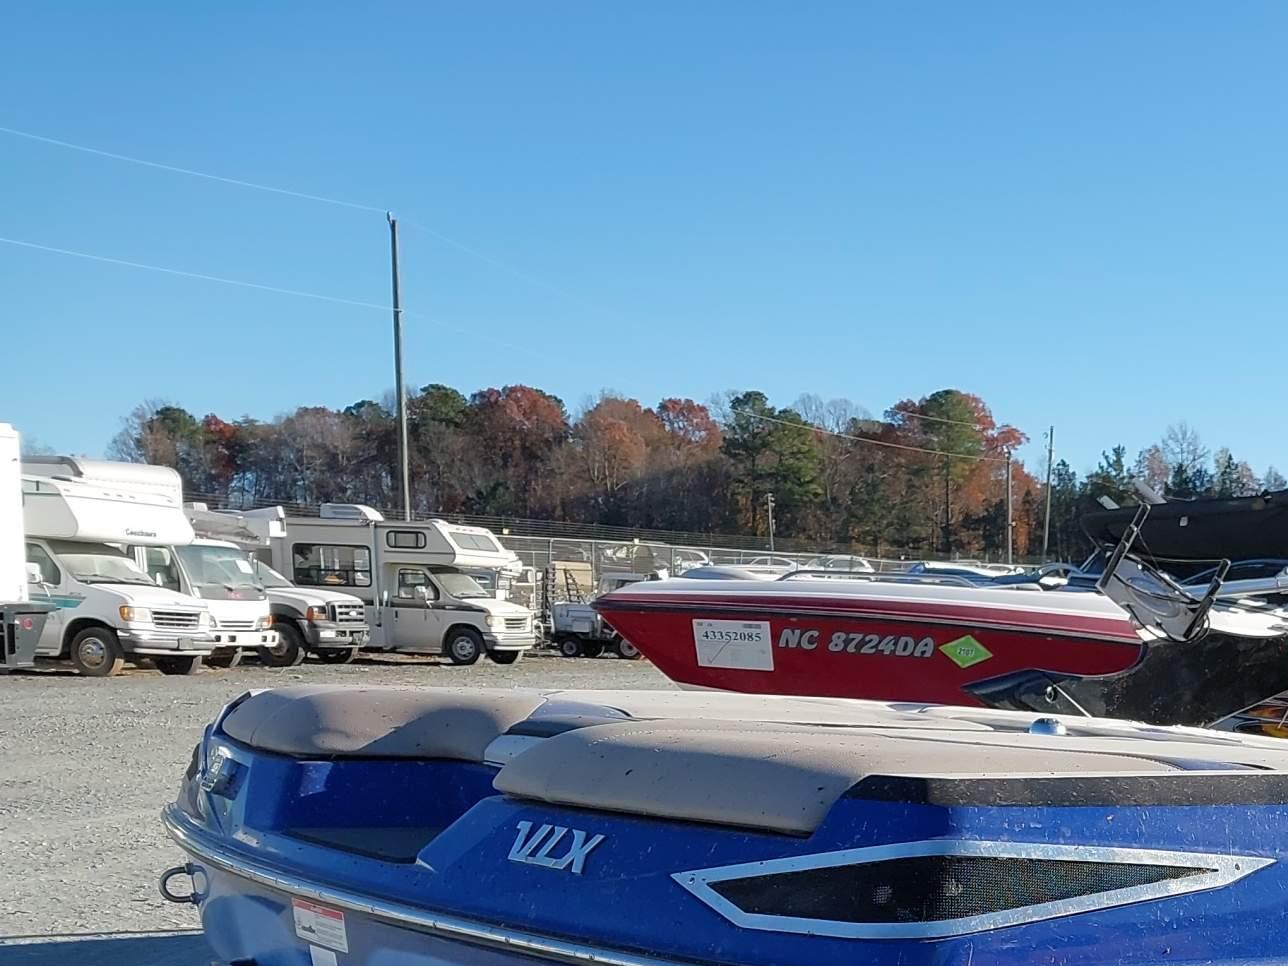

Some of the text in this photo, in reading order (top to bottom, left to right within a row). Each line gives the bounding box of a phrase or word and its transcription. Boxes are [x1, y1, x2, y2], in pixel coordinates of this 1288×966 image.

[702, 630, 762, 642] 43352085
[778, 629, 820, 649] NC
[828, 631, 935, 657] 8724DA
[508, 820, 606, 874] VLX
